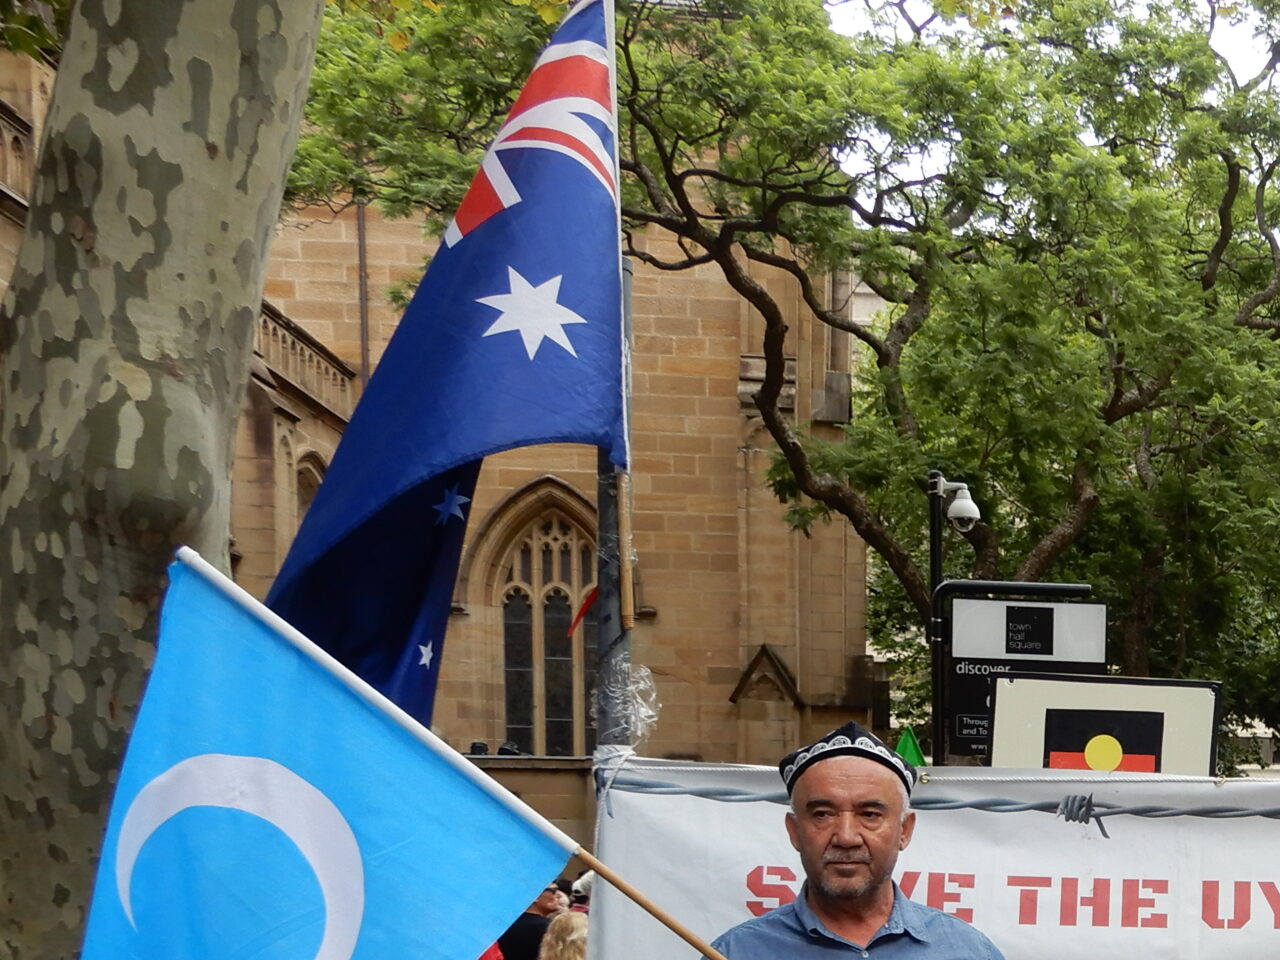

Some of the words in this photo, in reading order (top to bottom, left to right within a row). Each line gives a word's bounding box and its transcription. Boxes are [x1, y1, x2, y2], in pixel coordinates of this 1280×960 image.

[1009, 622, 1032, 631] town
[1009, 631, 1025, 640] hall
[1009, 641, 1041, 650] square
[956, 661, 1011, 675] discover
[962, 717, 989, 728] Throug
[962, 727, 977, 735] and
[978, 727, 988, 735] To
[1008, 876, 1168, 929] THE
